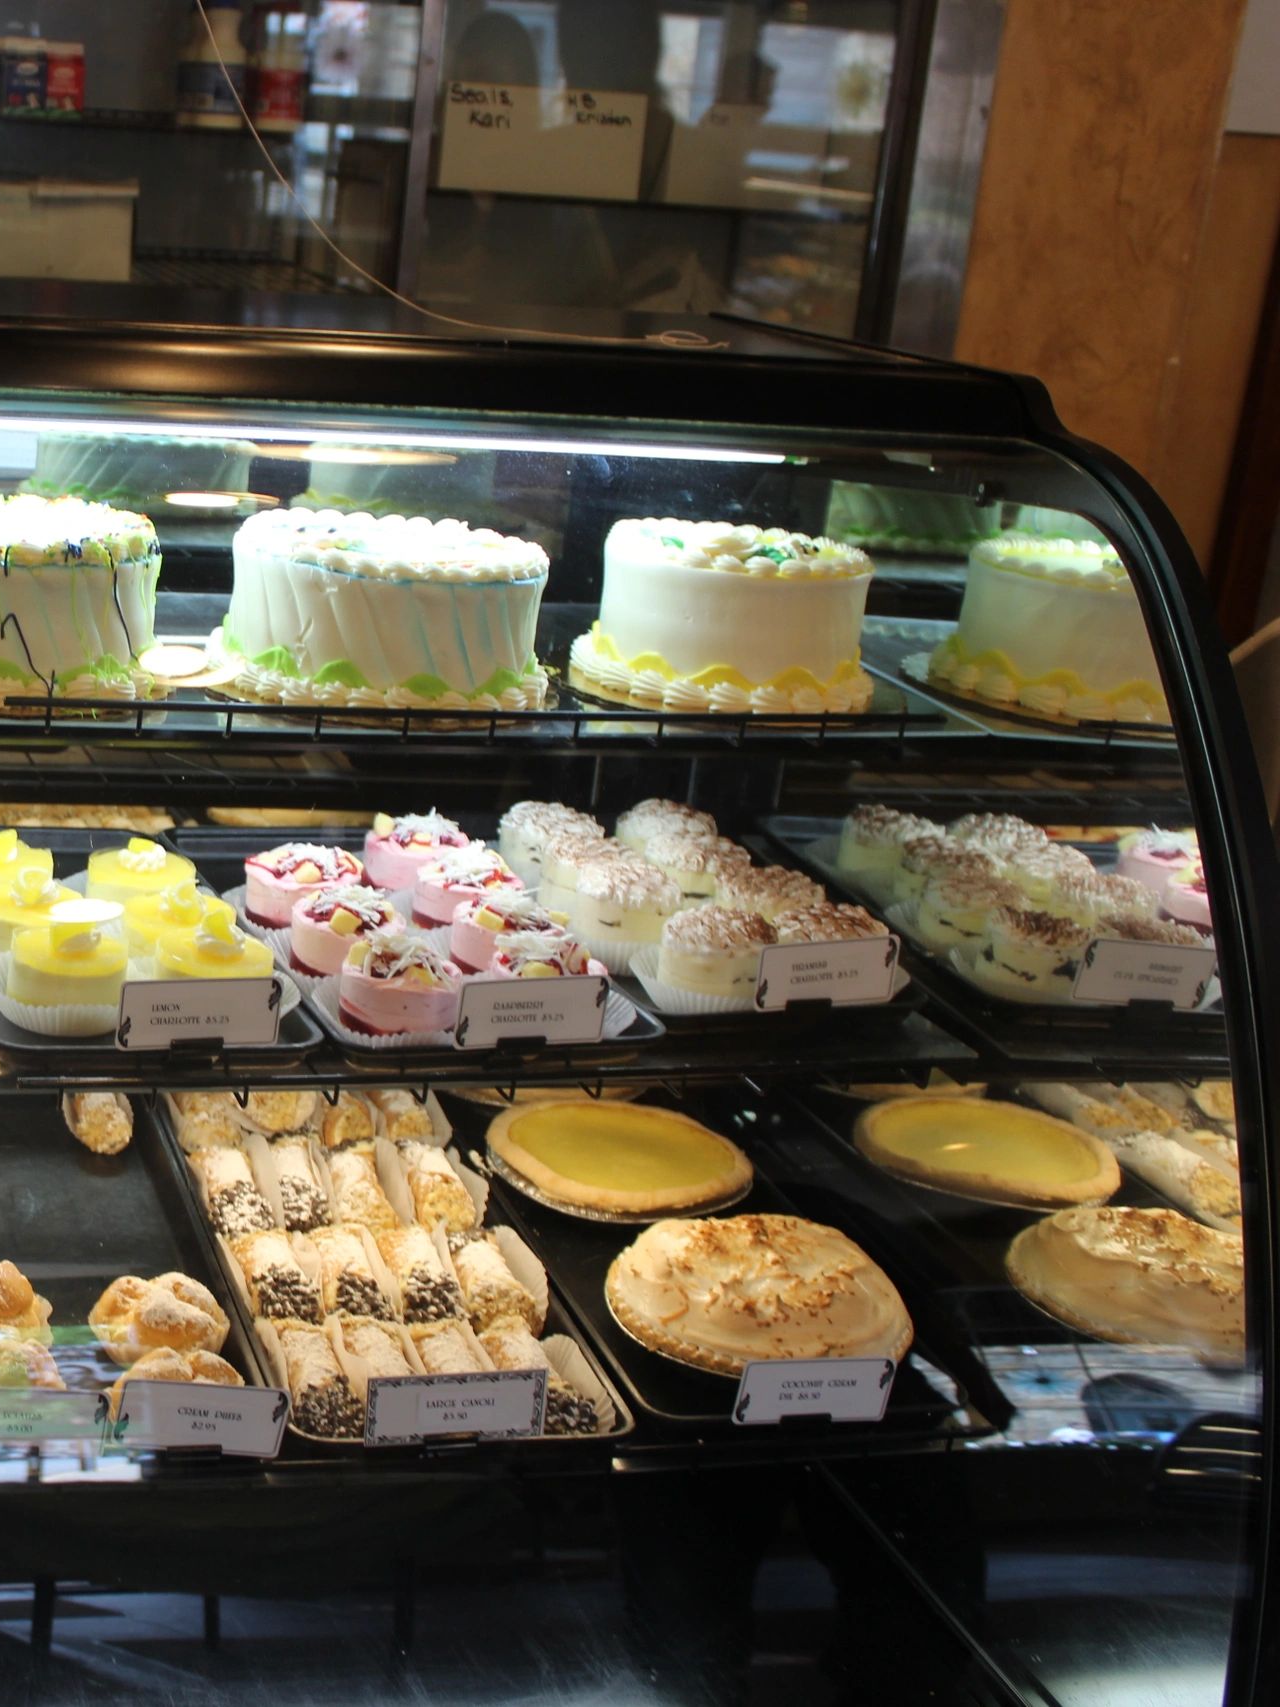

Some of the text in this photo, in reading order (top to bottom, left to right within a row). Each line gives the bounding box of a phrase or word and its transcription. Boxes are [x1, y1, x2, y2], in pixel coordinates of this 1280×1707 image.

[152, 1003, 181, 1012] LEMON
[150, 1015, 200, 1025] CHARLOTTE
[490, 1013, 537, 1024] CHARLOTTE
[426, 1399, 456, 1409] LARGE
[177, 1406, 209, 1417] CREAM
